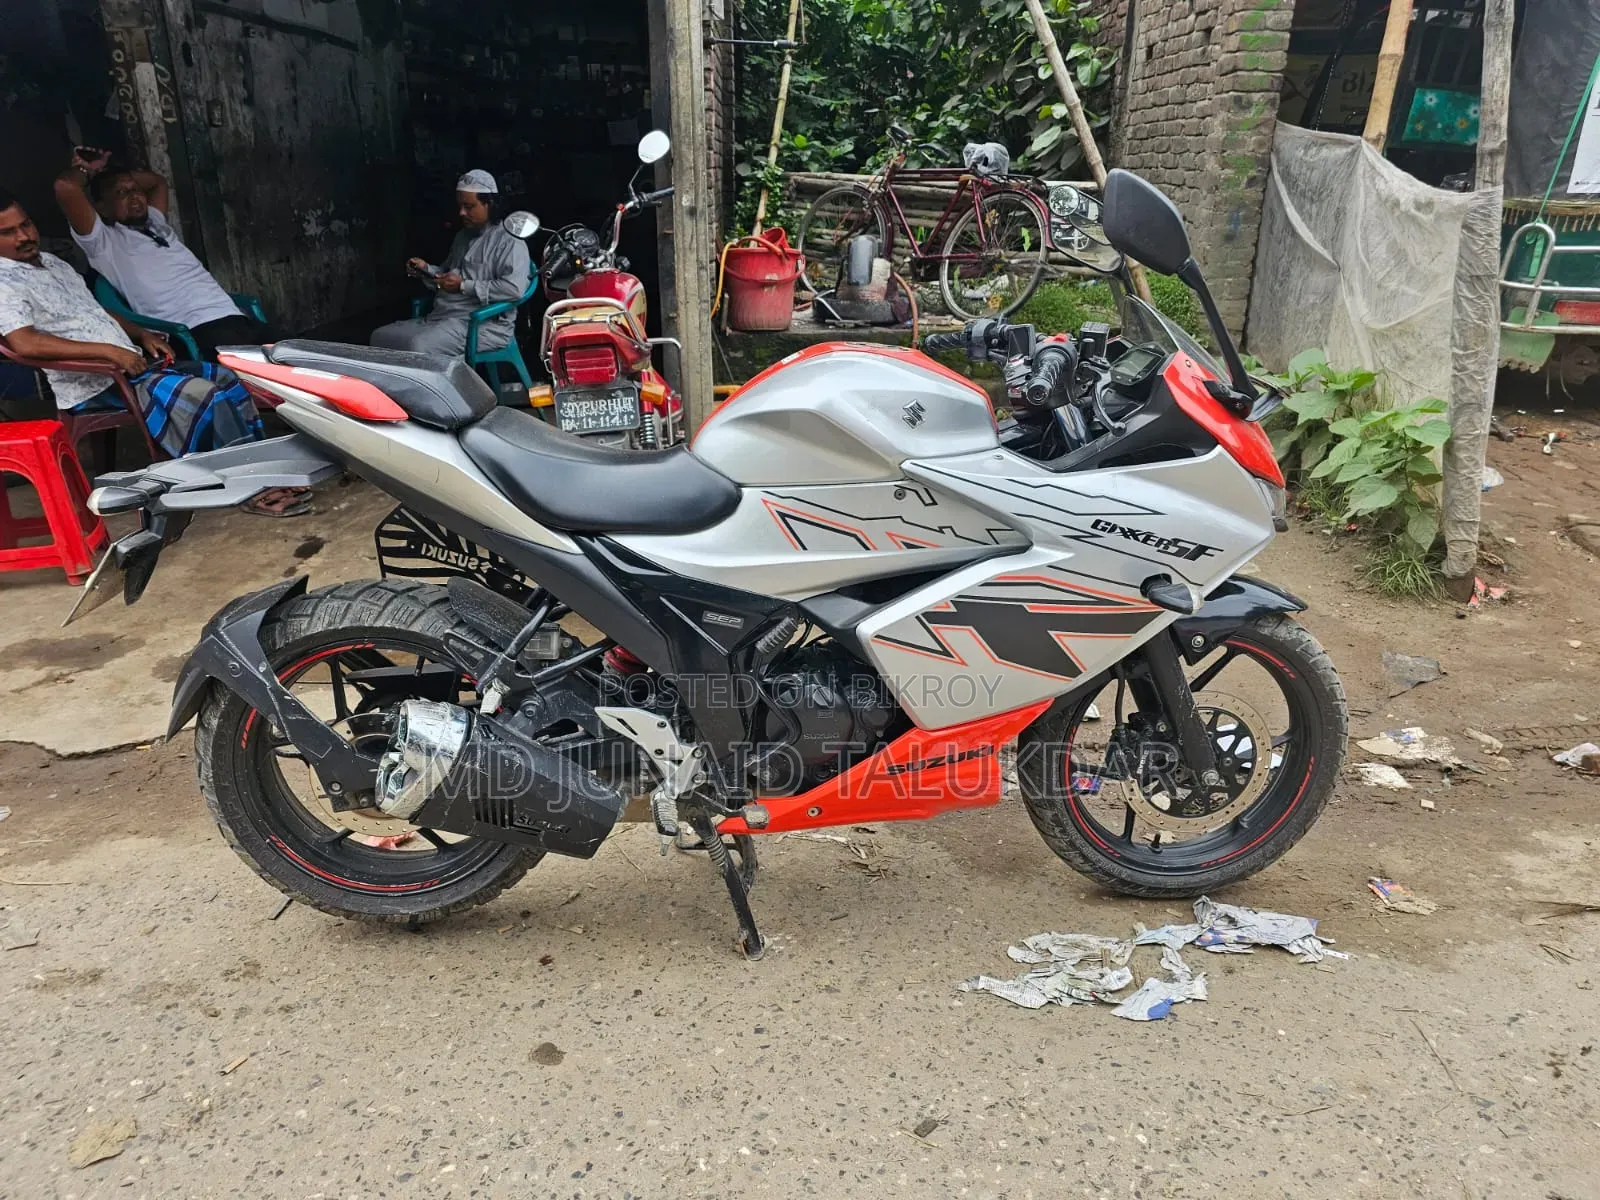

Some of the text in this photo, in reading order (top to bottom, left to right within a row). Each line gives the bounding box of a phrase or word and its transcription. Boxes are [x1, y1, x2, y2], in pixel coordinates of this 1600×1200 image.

[1090, 518, 1225, 562] GIXXER SF
[706, 613, 741, 624] SEP
[887, 745, 995, 776] SUZUKI
